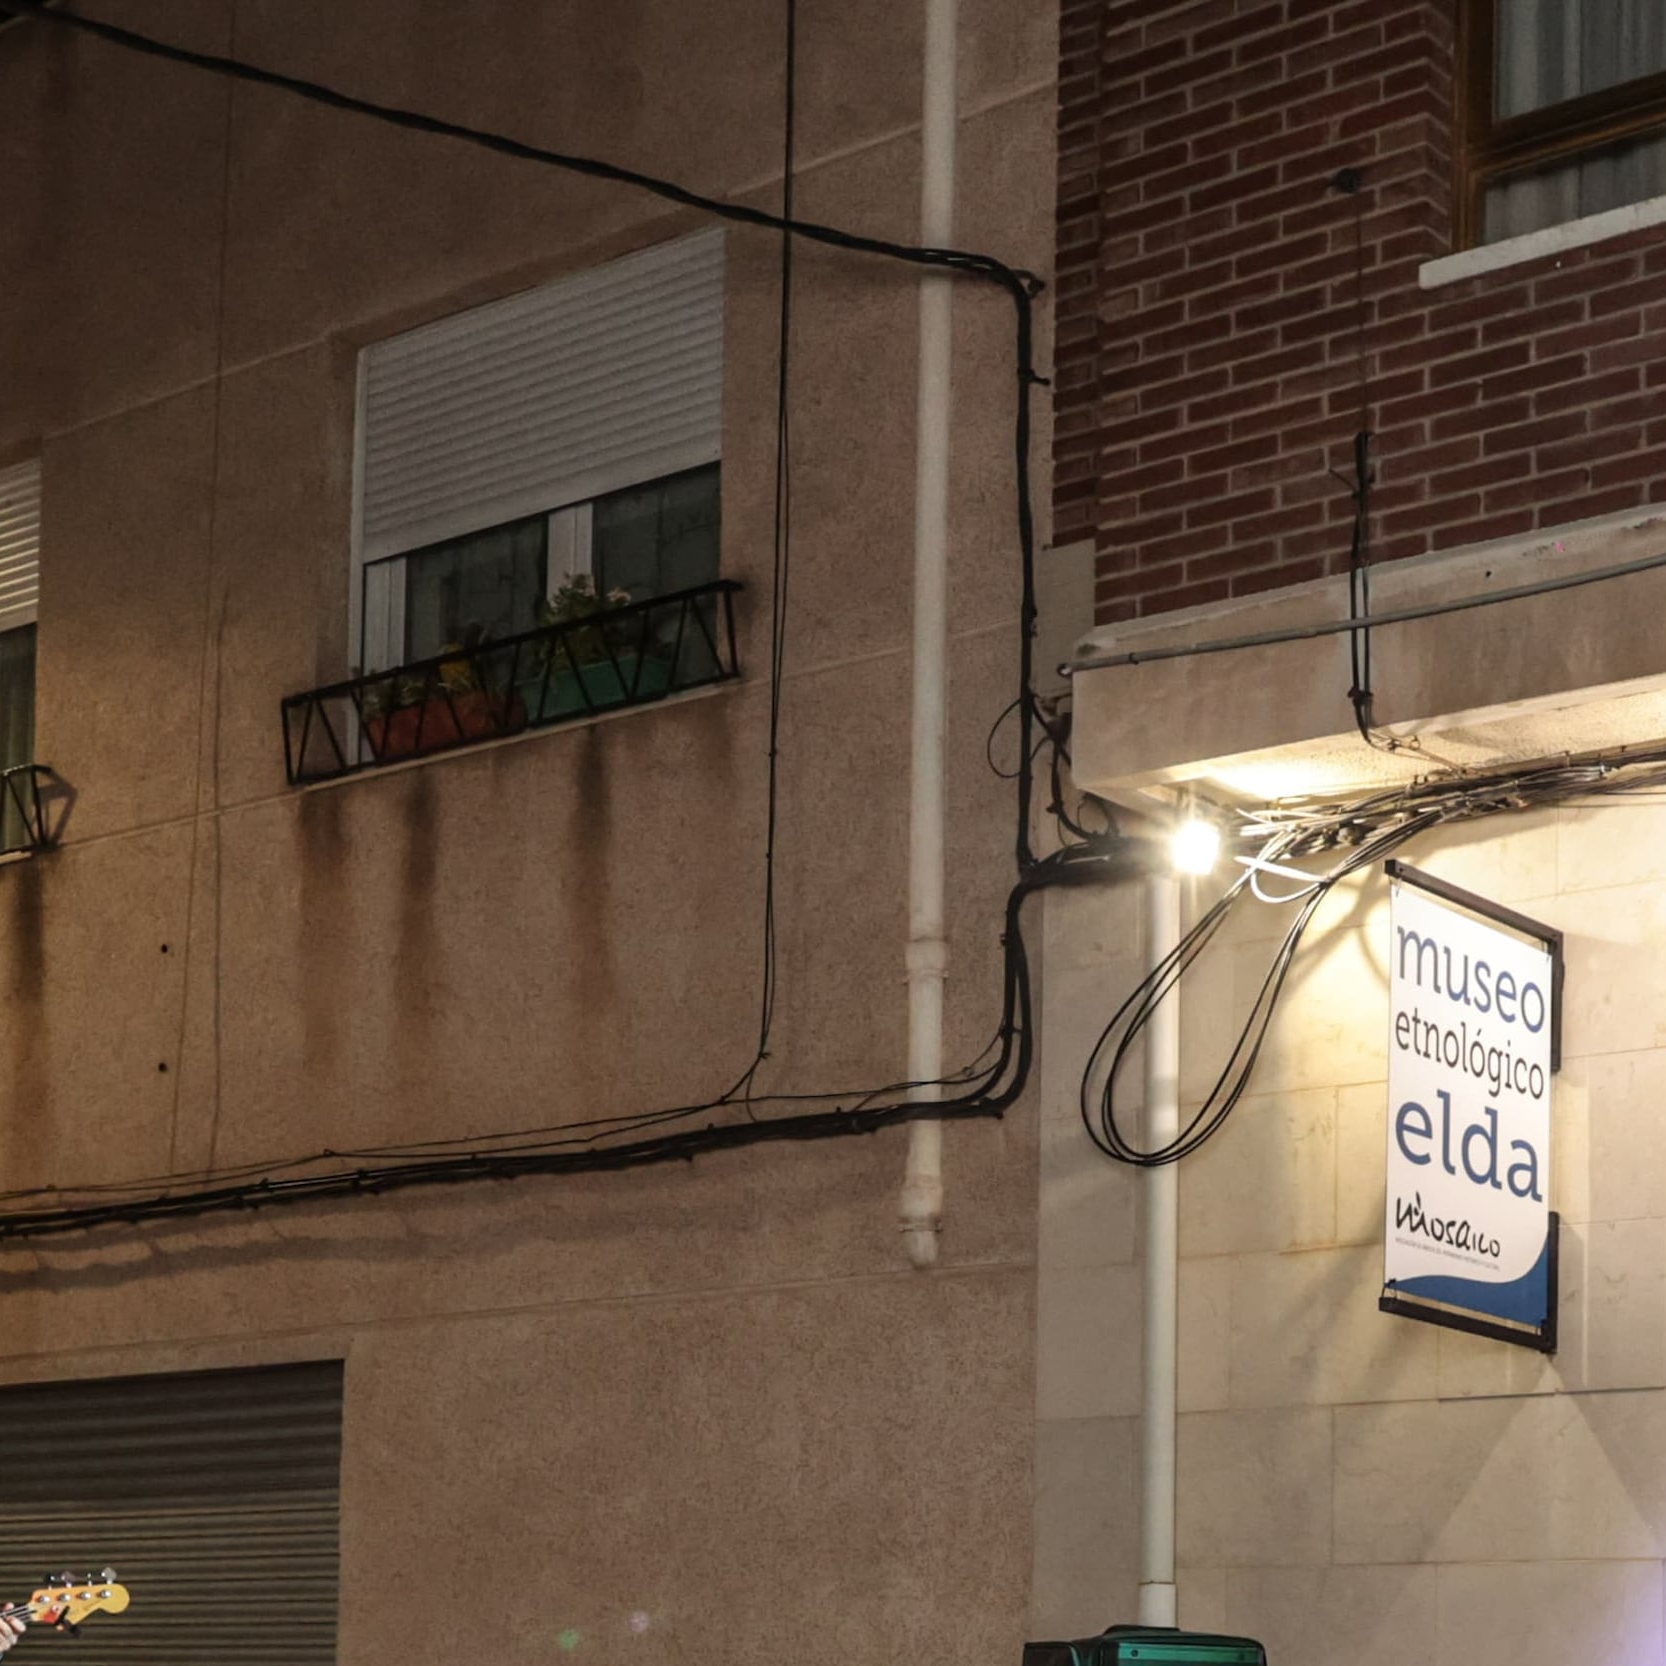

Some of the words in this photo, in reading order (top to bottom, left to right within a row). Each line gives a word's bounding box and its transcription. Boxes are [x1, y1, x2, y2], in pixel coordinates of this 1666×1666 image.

[1396, 925, 1546, 1034] museo
[1395, 1007, 1545, 1100] etnológico
[1395, 1090, 1543, 1203] elda
